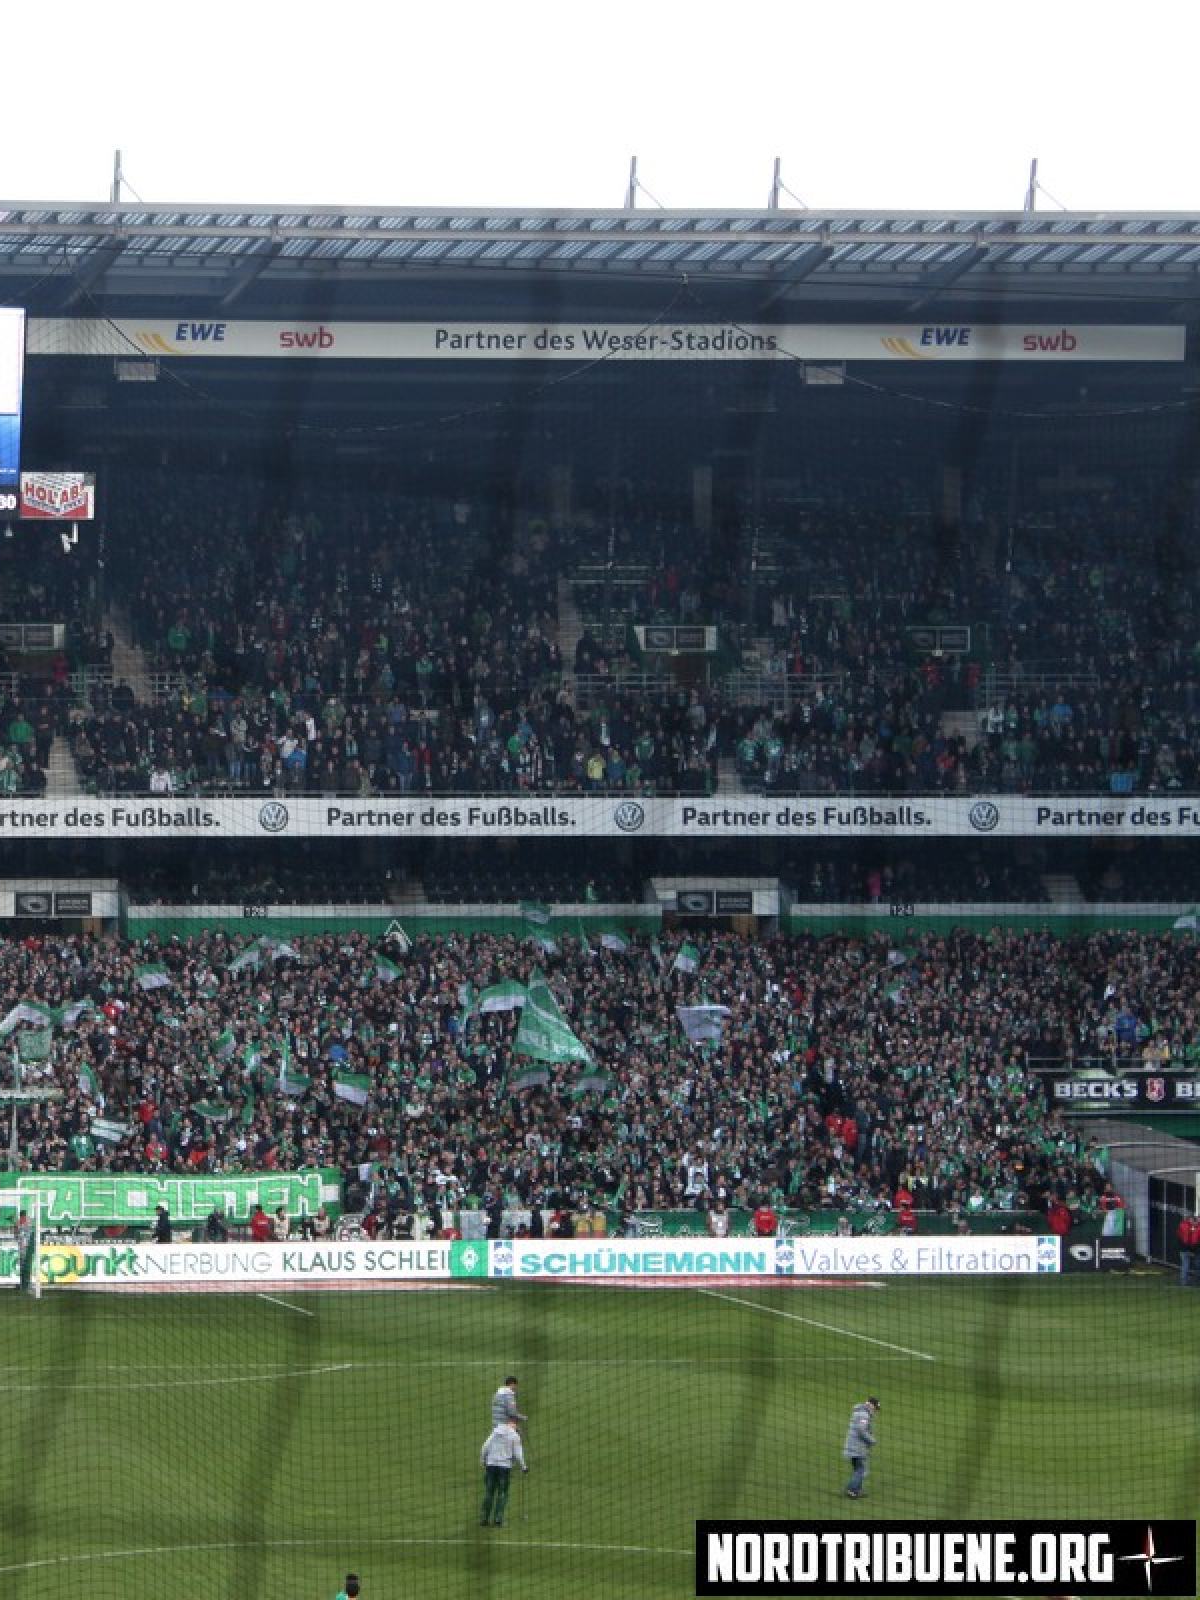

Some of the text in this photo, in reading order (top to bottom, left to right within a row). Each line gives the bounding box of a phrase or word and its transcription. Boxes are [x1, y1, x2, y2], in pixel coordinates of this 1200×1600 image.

[175, 323, 227, 341] EWE
[280, 326, 334, 349] swb
[435, 329, 777, 351] Partner des Weser-Stadions
[920, 327, 972, 347] EWE
[1023, 329, 1077, 351] swb
[64, 806, 105, 828] des
[111, 806, 221, 828] Fußballs.
[327, 806, 577, 827] Partner des Fußballs.
[682, 805, 932, 827] Partner des Fußballs.
[1037, 806, 1126, 827] Partner
[1130, 806, 1171, 827] des
[1054, 1080, 1139, 1098] BECK'S
[282, 1250, 357, 1273] KLAUS
[520, 1248, 767, 1273] SCHÜNEMANN
[800, 1247, 1031, 1272] Valves & Filtration
